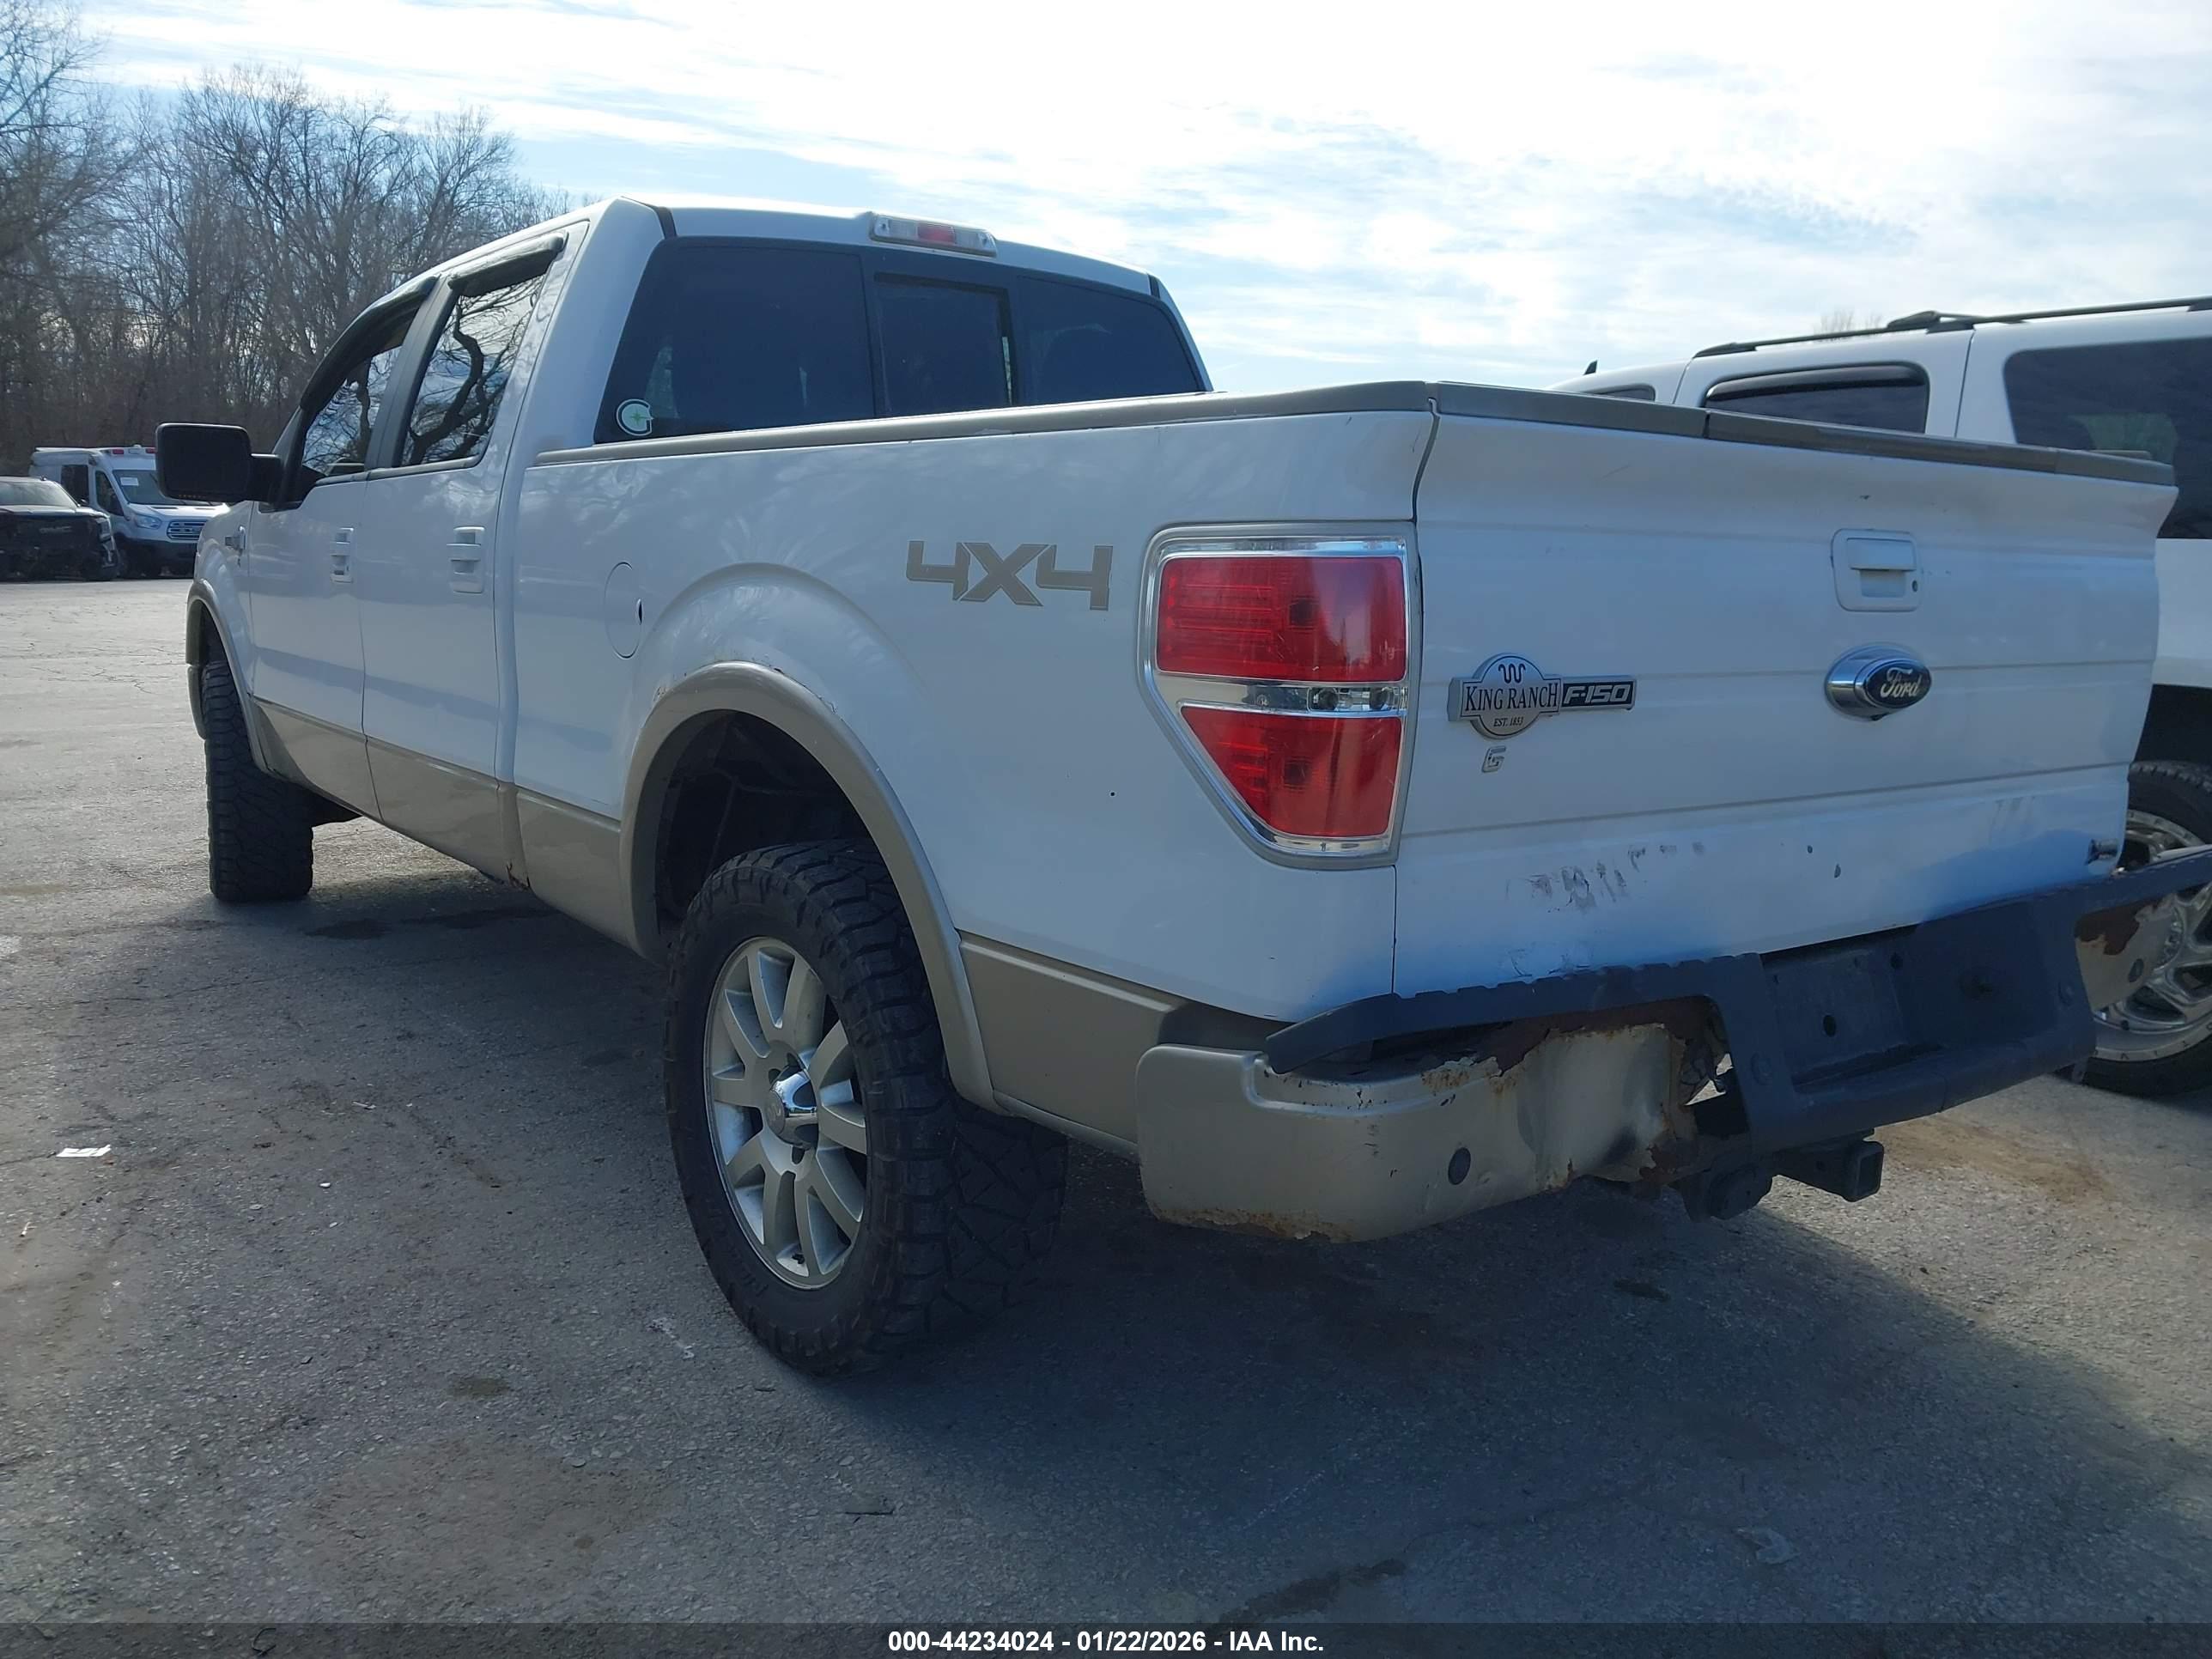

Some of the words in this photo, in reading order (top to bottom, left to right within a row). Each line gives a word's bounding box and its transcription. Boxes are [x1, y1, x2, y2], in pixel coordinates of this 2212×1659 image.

[906, 539, 1114, 611] 4X4
[1465, 686, 1504, 711] KING
[1508, 683, 1559, 709] RANCH
[1564, 684, 1631, 704] F-150
[1880, 667, 1923, 698] Ford
